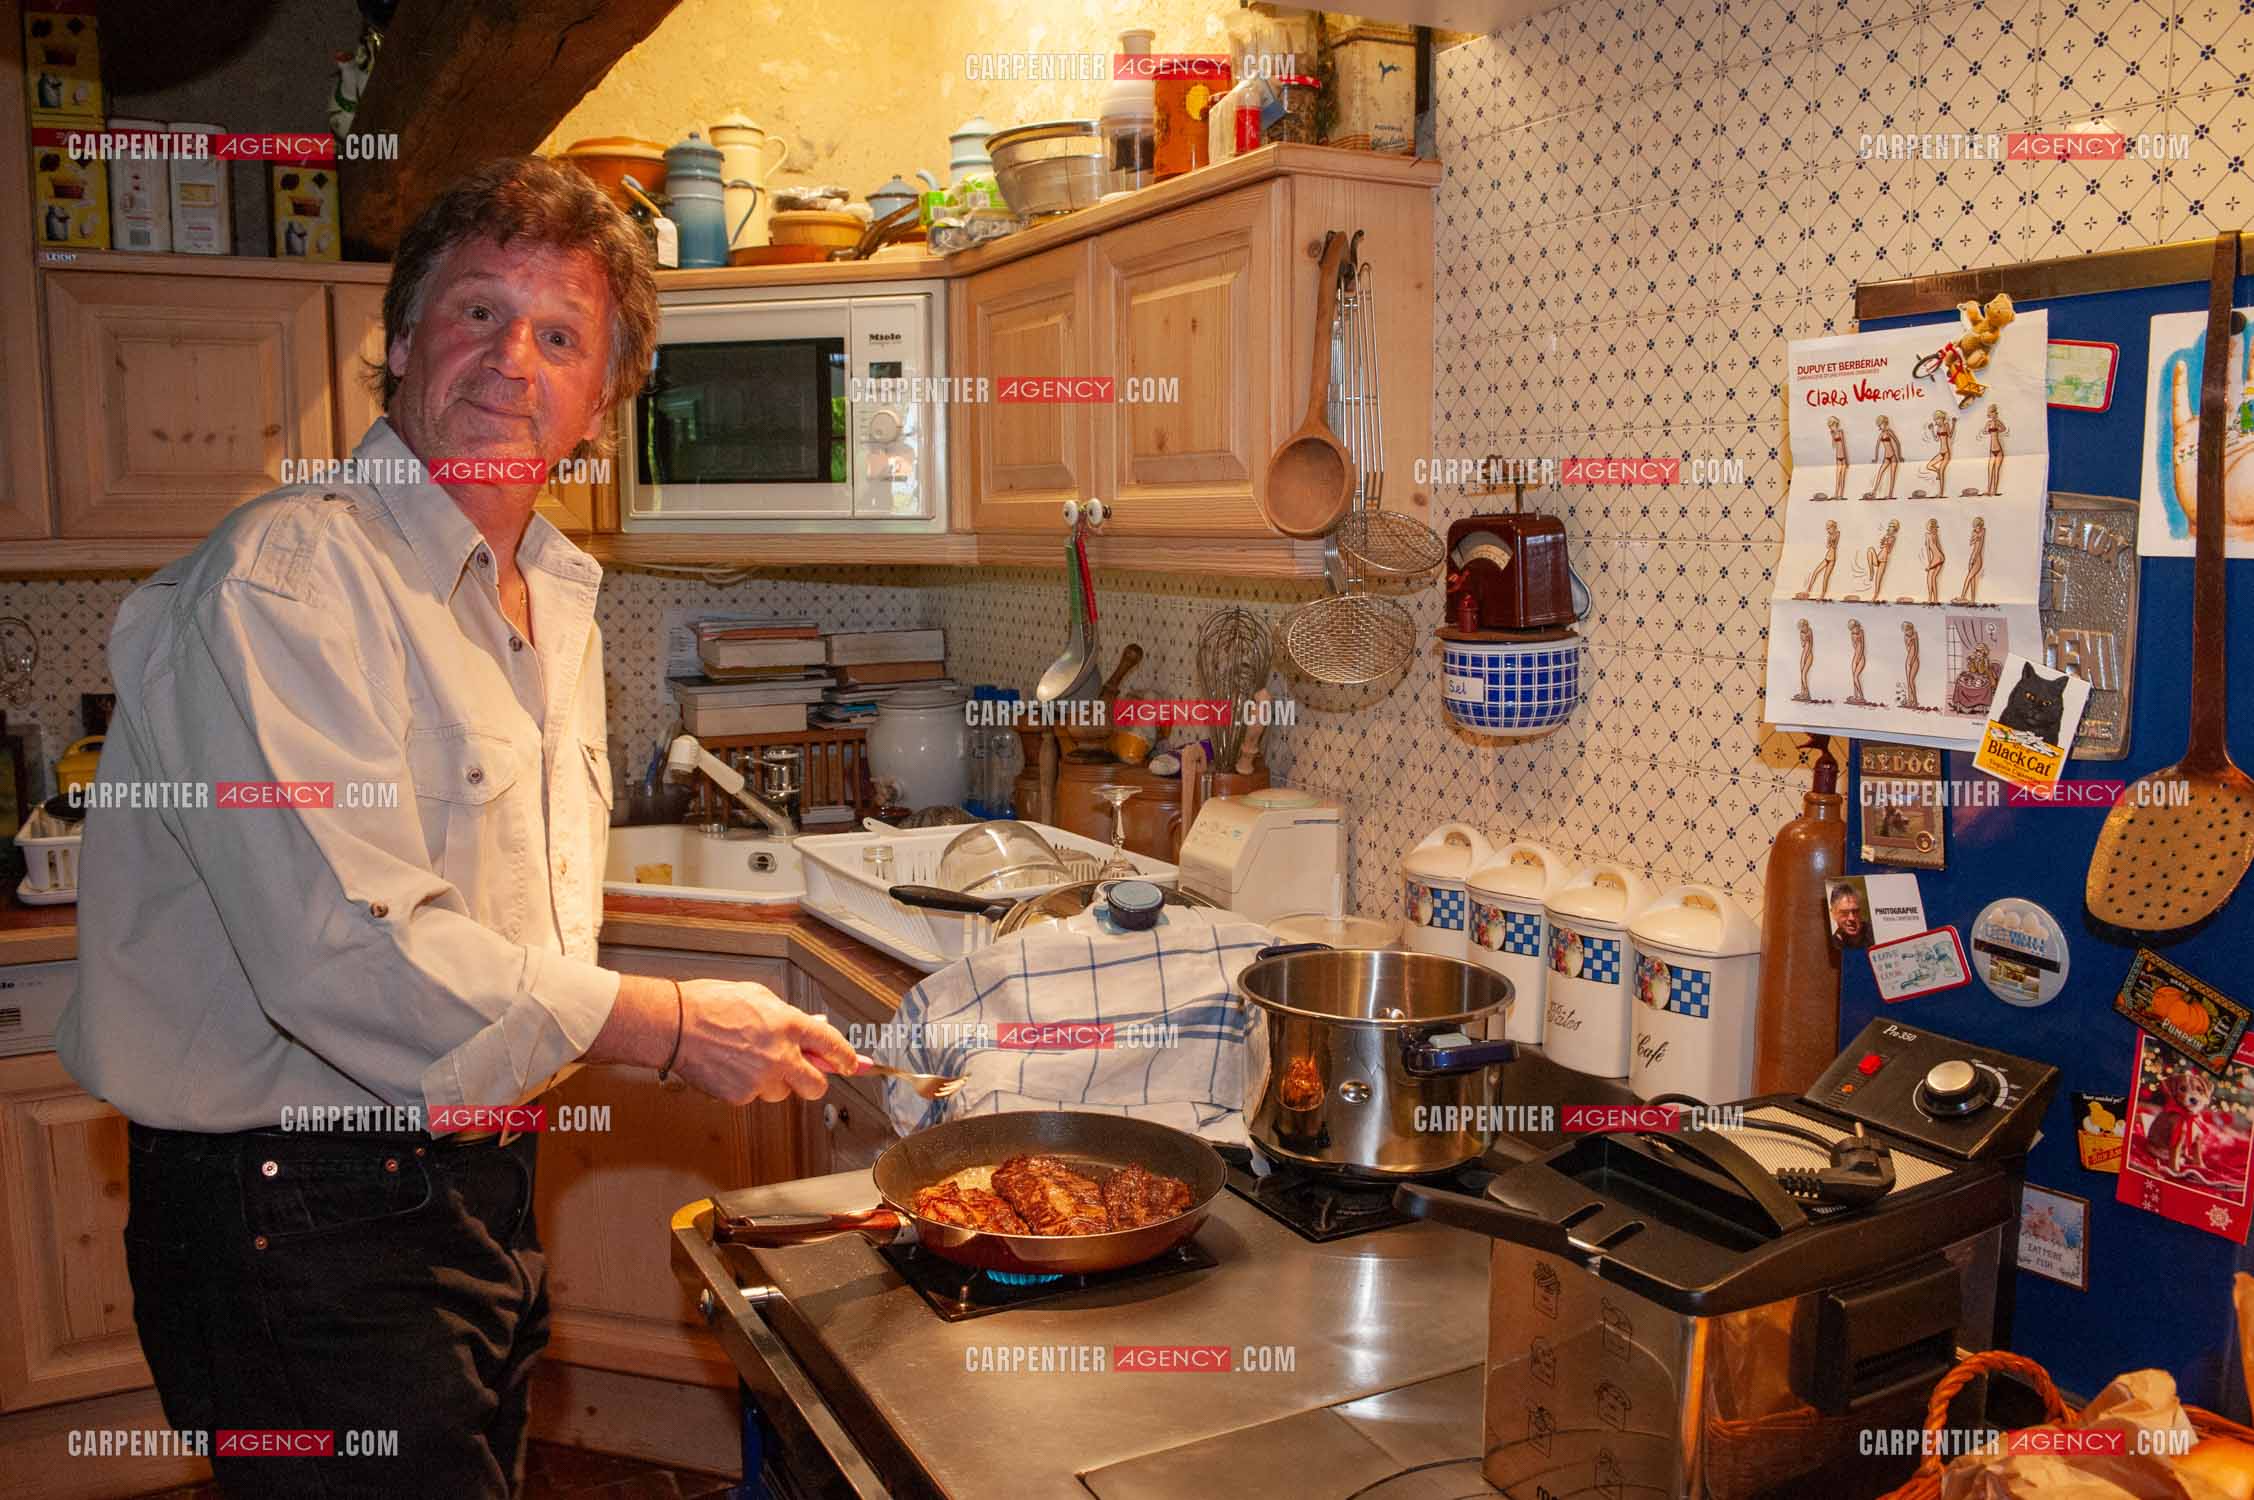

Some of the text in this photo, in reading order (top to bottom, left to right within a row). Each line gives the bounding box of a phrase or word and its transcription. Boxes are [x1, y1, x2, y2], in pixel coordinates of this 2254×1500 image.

[1797, 364, 1827, 375] DUPUY
[1827, 362, 1837, 372] ET
[1839, 357, 1888, 371] BERBERIAN
[1987, 739, 2027, 767] Black
[2027, 757, 2053, 777] Cat
[1636, 1031, 1670, 1069] Café
